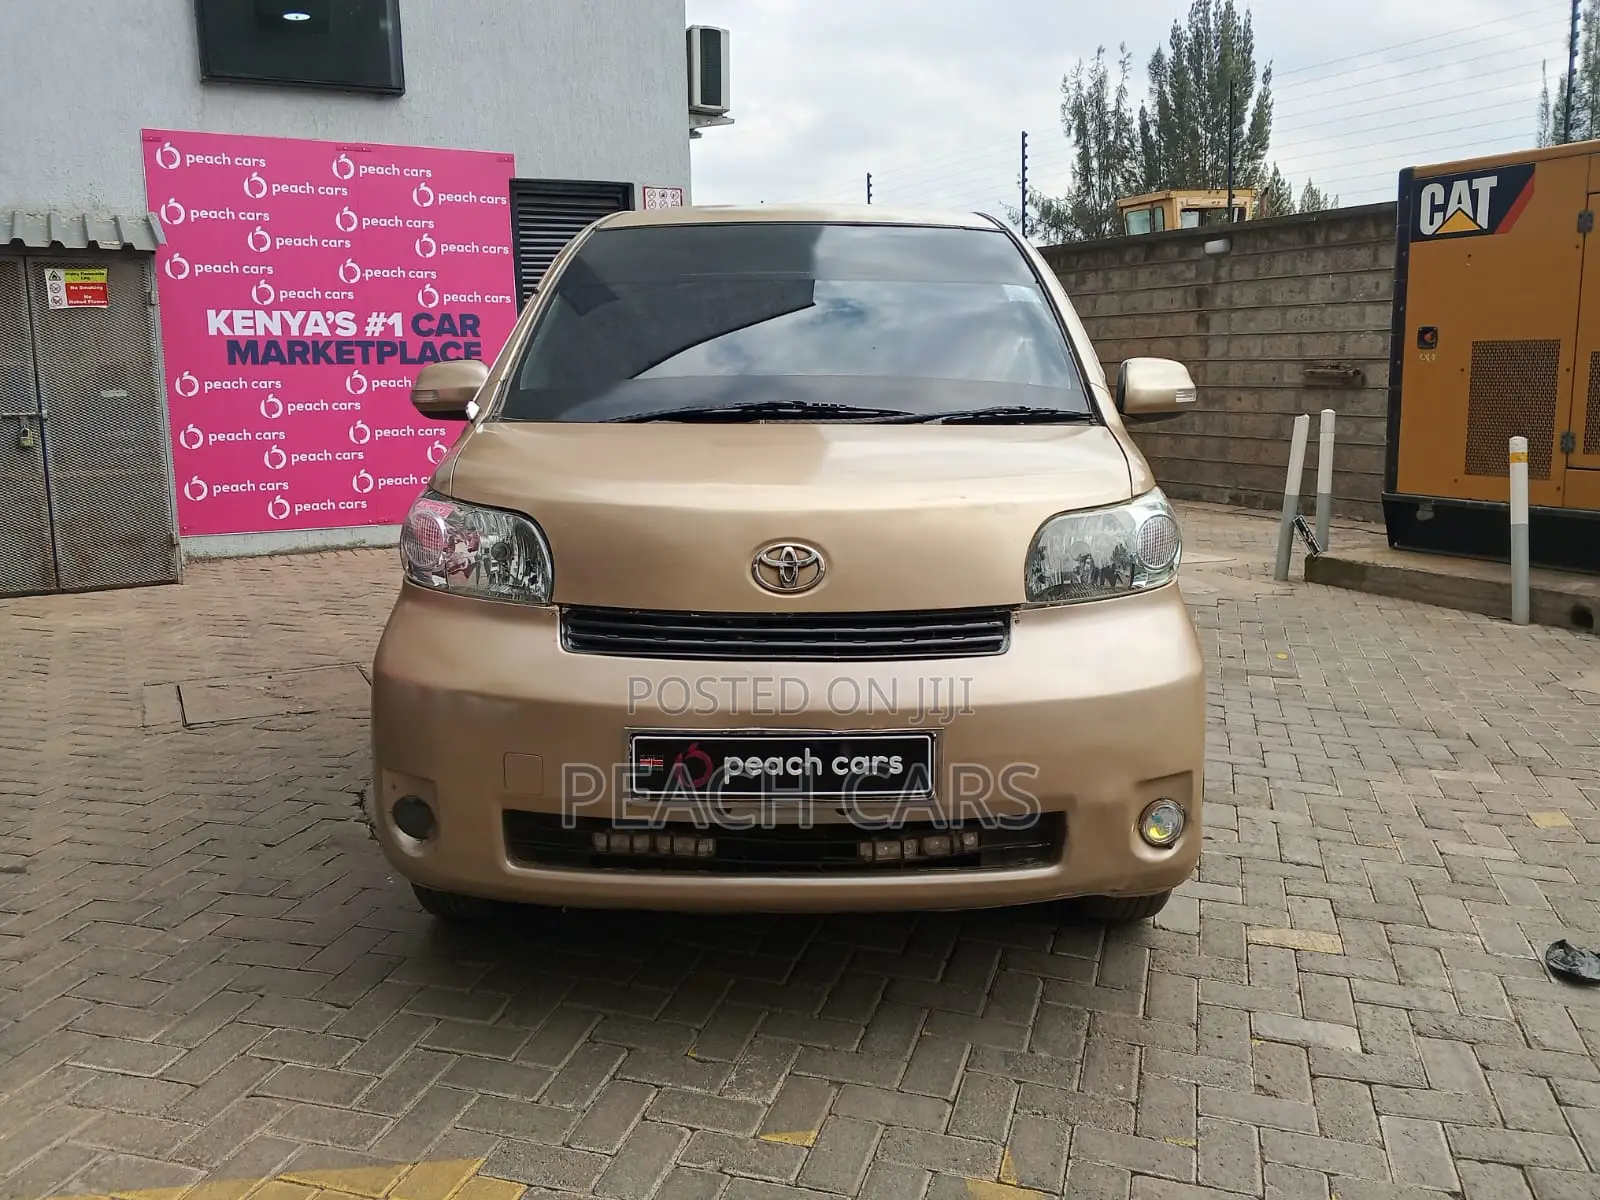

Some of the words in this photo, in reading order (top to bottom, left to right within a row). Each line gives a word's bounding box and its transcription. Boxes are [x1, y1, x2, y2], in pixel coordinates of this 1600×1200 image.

[186, 152, 231, 167] peach
[234, 156, 267, 168] cars
[360, 163, 400, 177] peach
[403, 168, 433, 178] cars
[272, 181, 314, 195] peach
[317, 186, 348, 196] cars
[439, 191, 476, 204] peach
[479, 195, 507, 205] cars
[1420, 176, 1497, 235] CAT
[190, 207, 235, 222] peach
[238, 211, 270, 222] cars
[363, 215, 402, 229] peach
[405, 219, 435, 229] cars
[276, 234, 318, 249] peach
[321, 239, 352, 249] cars
[441, 241, 479, 255] peach
[481, 245, 509, 255] cars
[195, 260, 239, 276] peach
[242, 265, 274, 275] cars
[365, 266, 405, 280] peach
[408, 270, 437, 280] cars
[280, 287, 321, 302] peach
[324, 290, 354, 300] cars
[444, 291, 481, 305] peach
[484, 294, 512, 304] cars
[365, 311, 404, 337] #1
[412, 313, 480, 337] CAR
[227, 340, 481, 365] MARKETPLACE
[205, 376, 247, 393] peach
[251, 380, 282, 389] cars
[372, 375, 411, 390] peach
[288, 399, 328, 414] peach
[331, 401, 361, 411] cars
[209, 428, 251, 445] peach
[255, 431, 286, 441] cars
[375, 425, 414, 440] peach
[417, 427, 446, 437] cars
[292, 449, 332, 465] peach
[335, 451, 365, 461] cars
[213, 479, 255, 495] peach
[258, 481, 289, 491] cars
[379, 473, 417, 489] peach
[295, 498, 335, 514] peach
[338, 500, 368, 510] cars
[724, 747, 823, 784] peach
[831, 756, 904, 776] cars
